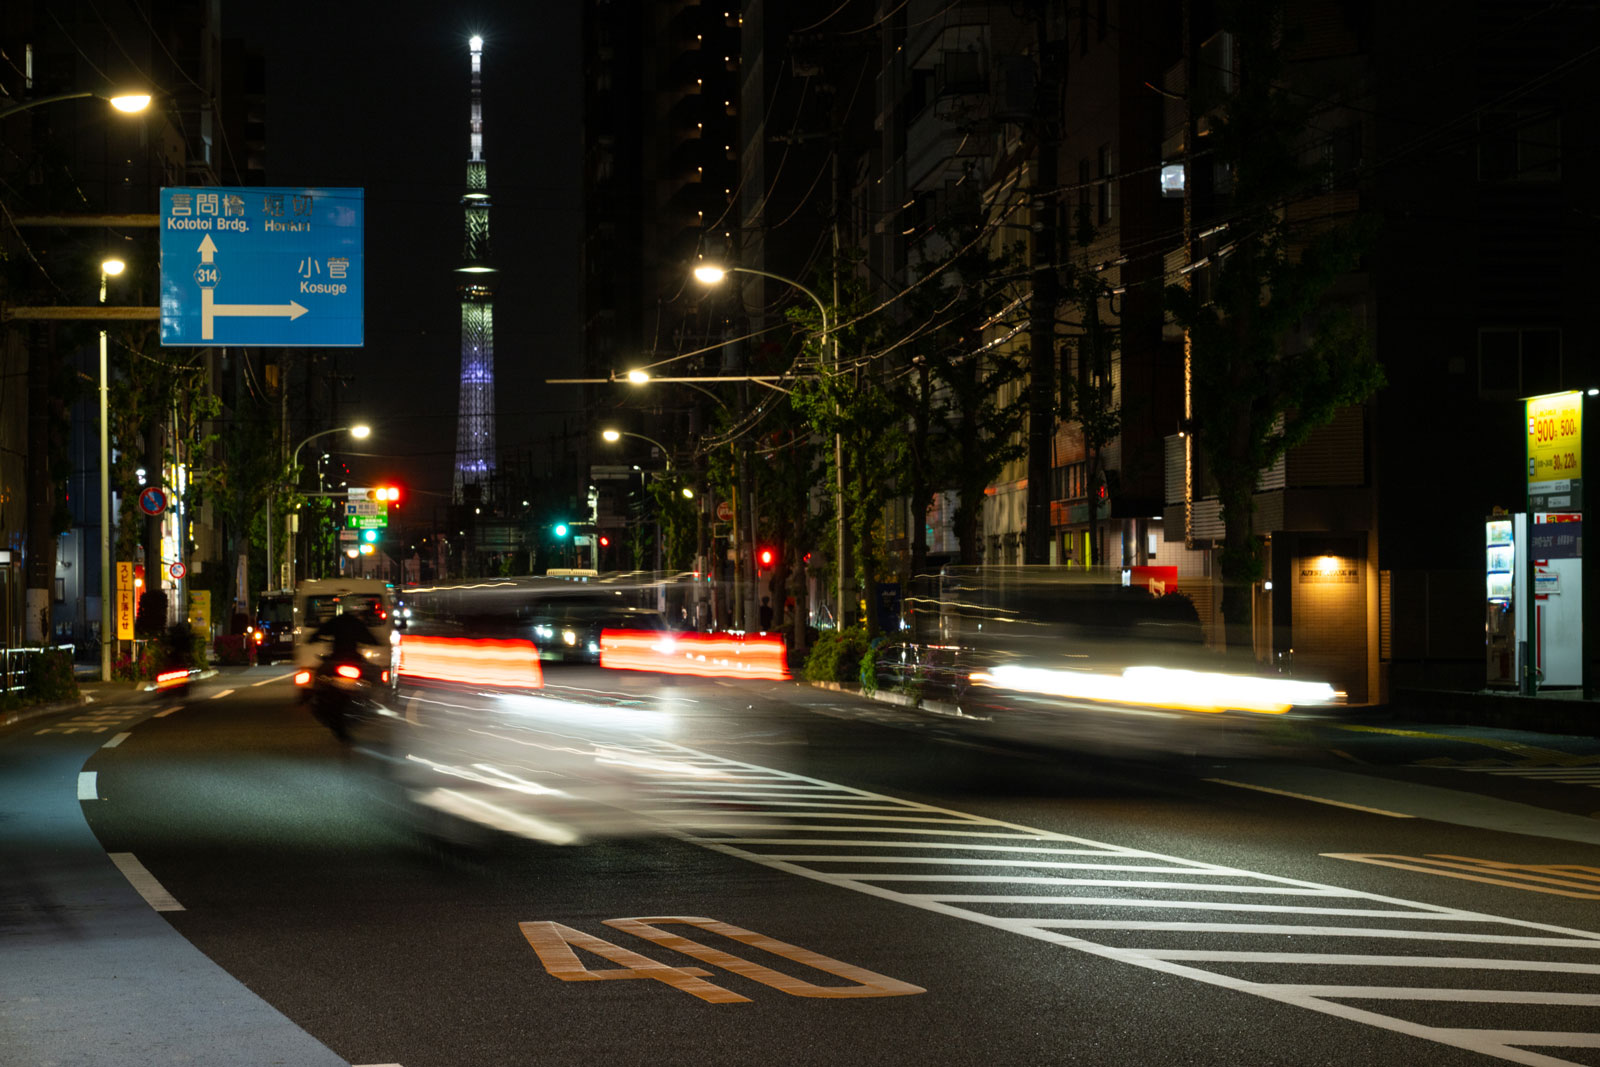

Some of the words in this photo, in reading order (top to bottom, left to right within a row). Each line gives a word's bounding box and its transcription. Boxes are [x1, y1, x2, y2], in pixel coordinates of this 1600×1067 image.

[170, 193, 245, 217] 言問橋
[167, 217, 212, 230] Kototoi
[217, 217, 250, 233] Brdg.
[198, 267, 218, 283] 314
[297, 256, 350, 279] 小菅
[300, 281, 347, 296] Kosuge
[120, 564, 129, 630] スピード落とせ
[518, 915, 928, 1004] 40
